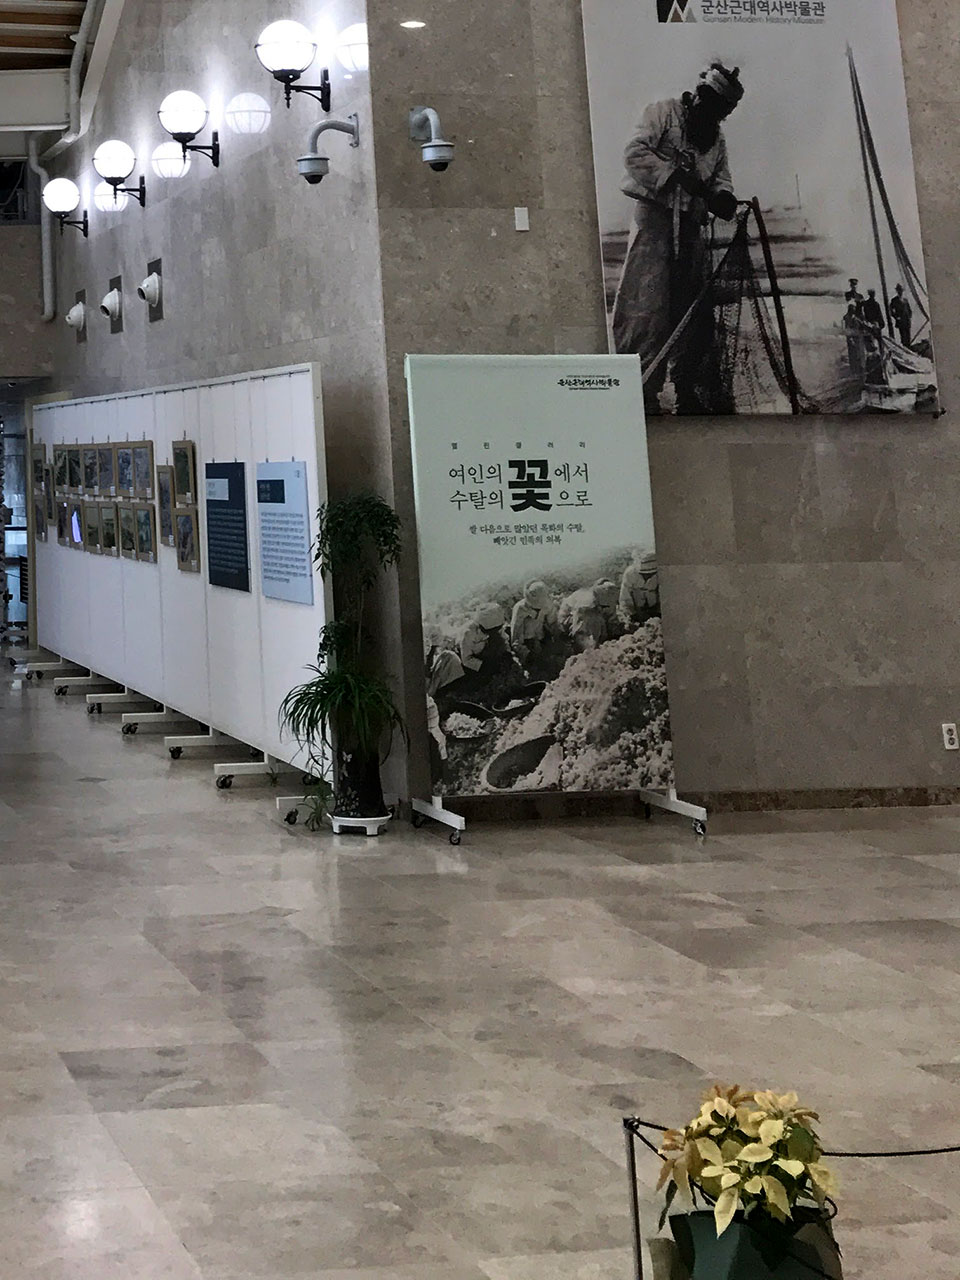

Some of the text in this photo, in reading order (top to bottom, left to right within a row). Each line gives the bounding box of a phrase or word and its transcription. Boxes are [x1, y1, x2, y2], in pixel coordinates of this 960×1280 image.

[700, 0, 826, 17] 군산근대역사박물관
[449, 459, 589, 512] 여인의 꽃 에서
[450, 489, 593, 511] 수탈의 으로
